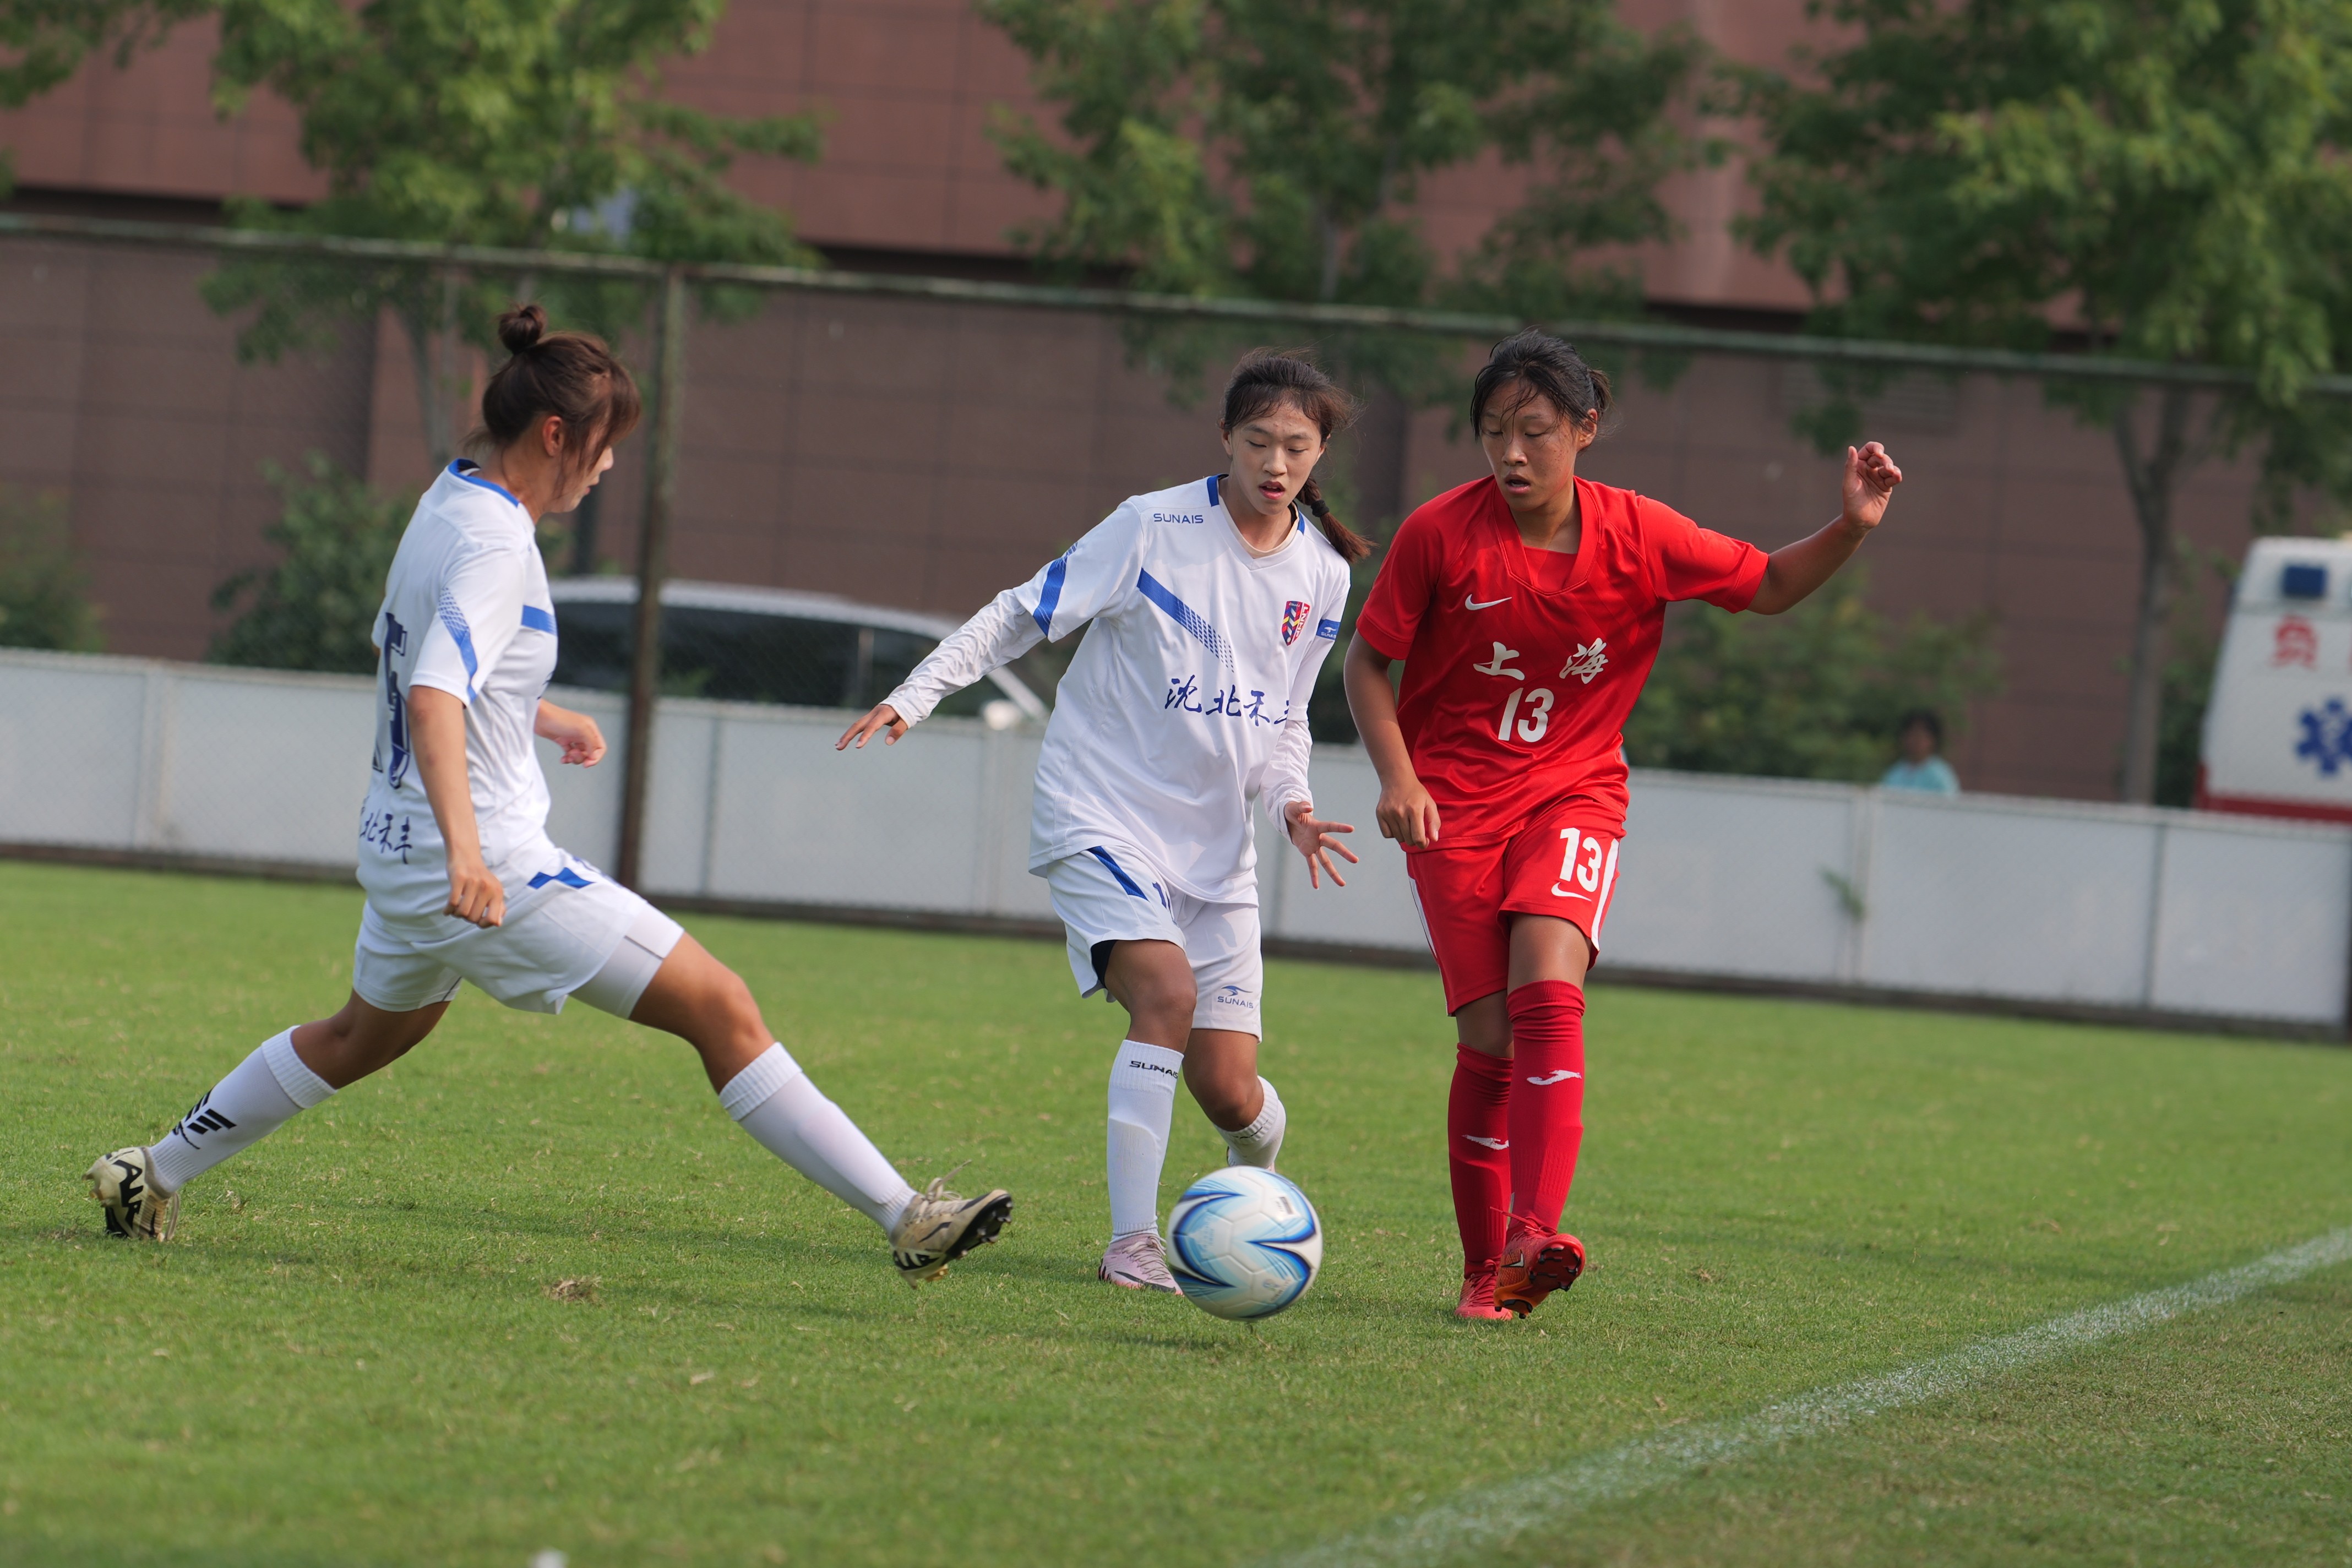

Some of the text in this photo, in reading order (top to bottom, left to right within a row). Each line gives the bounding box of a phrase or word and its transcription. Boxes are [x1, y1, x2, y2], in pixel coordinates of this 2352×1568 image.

[1153, 513, 1204, 524] SUNAIS
[1473, 638, 1608, 684] 上海
[1498, 687, 1554, 742] 13
[360, 796, 413, 865] 北禾丰
[1559, 827, 1602, 892] 13
[1217, 996, 1254, 1009] SUNAIS
